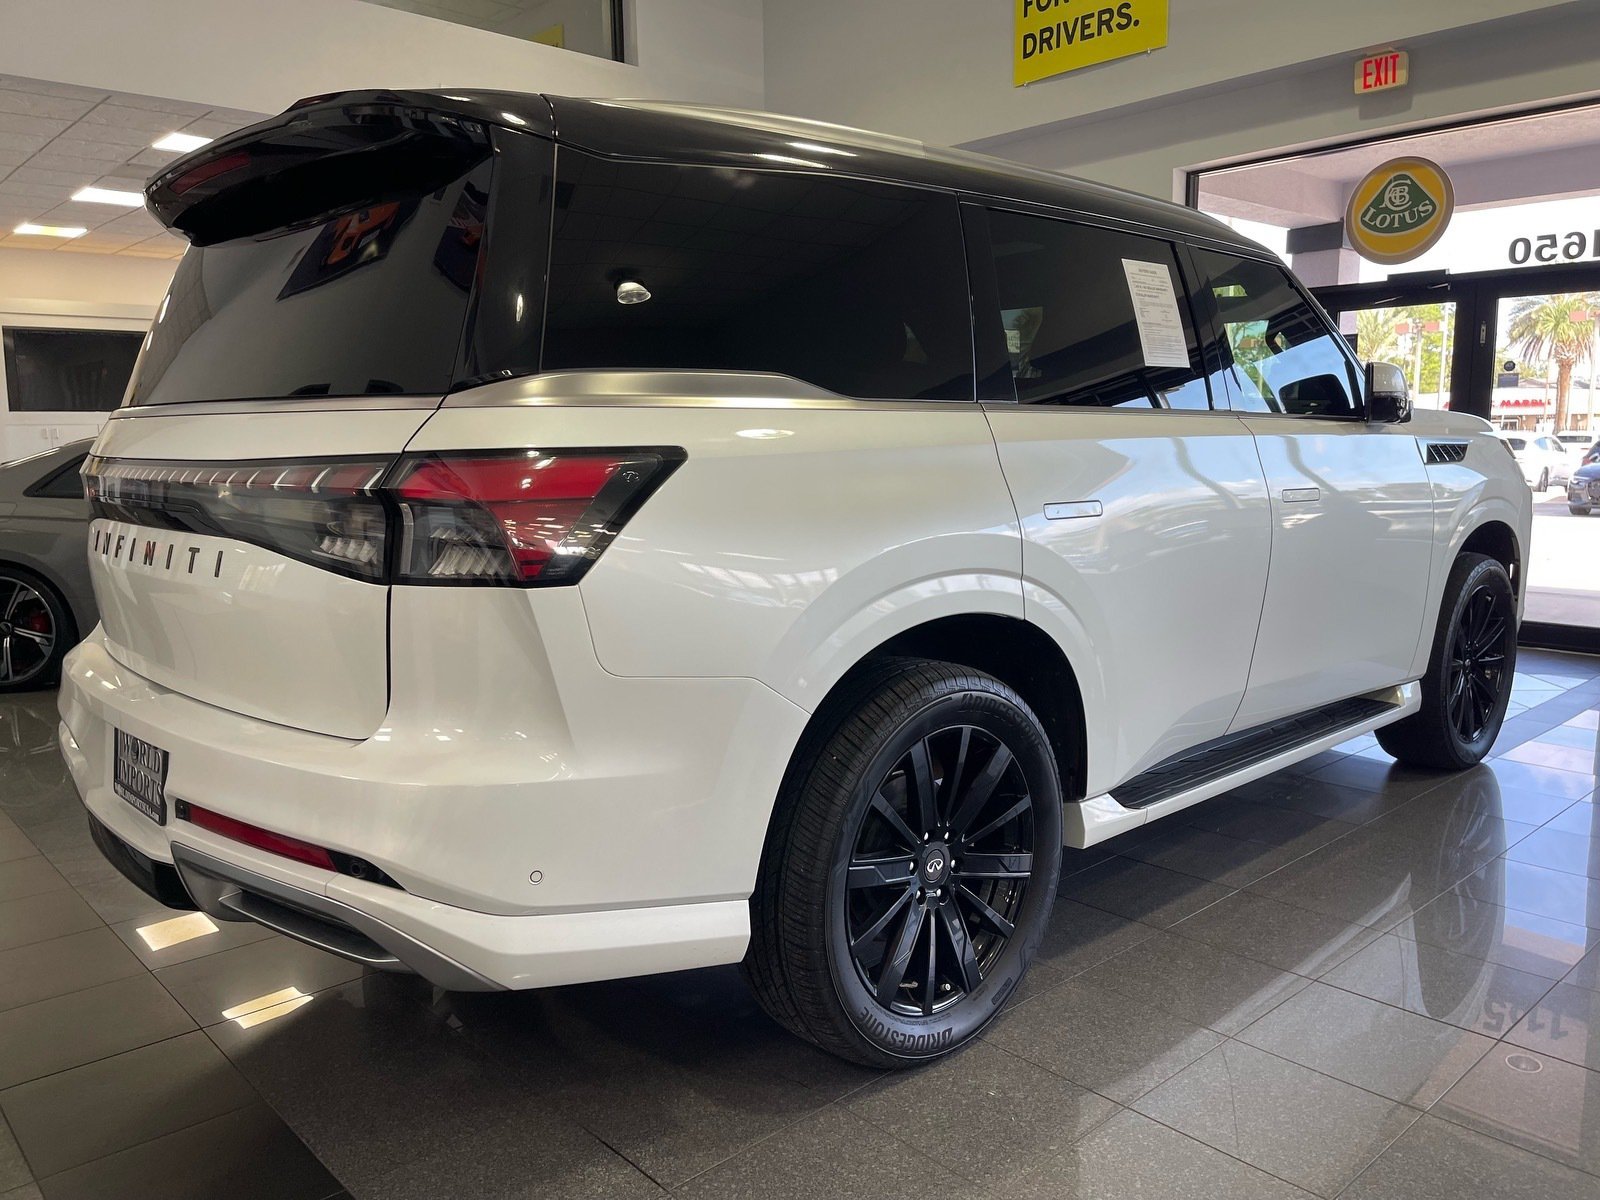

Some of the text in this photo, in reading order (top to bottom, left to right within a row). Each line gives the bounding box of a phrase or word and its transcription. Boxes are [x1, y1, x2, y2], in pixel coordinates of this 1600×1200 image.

[1022, 2, 1140, 60] DRIVERS.
[1363, 53, 1400, 90] EXIT
[1362, 200, 1433, 228] LOTUS
[94, 530, 224, 578] INFINITI
[120, 732, 162, 774] WORLD
[119, 759, 163, 808] IMPORTS
[858, 1006, 953, 1051] BRIDGESTONE
